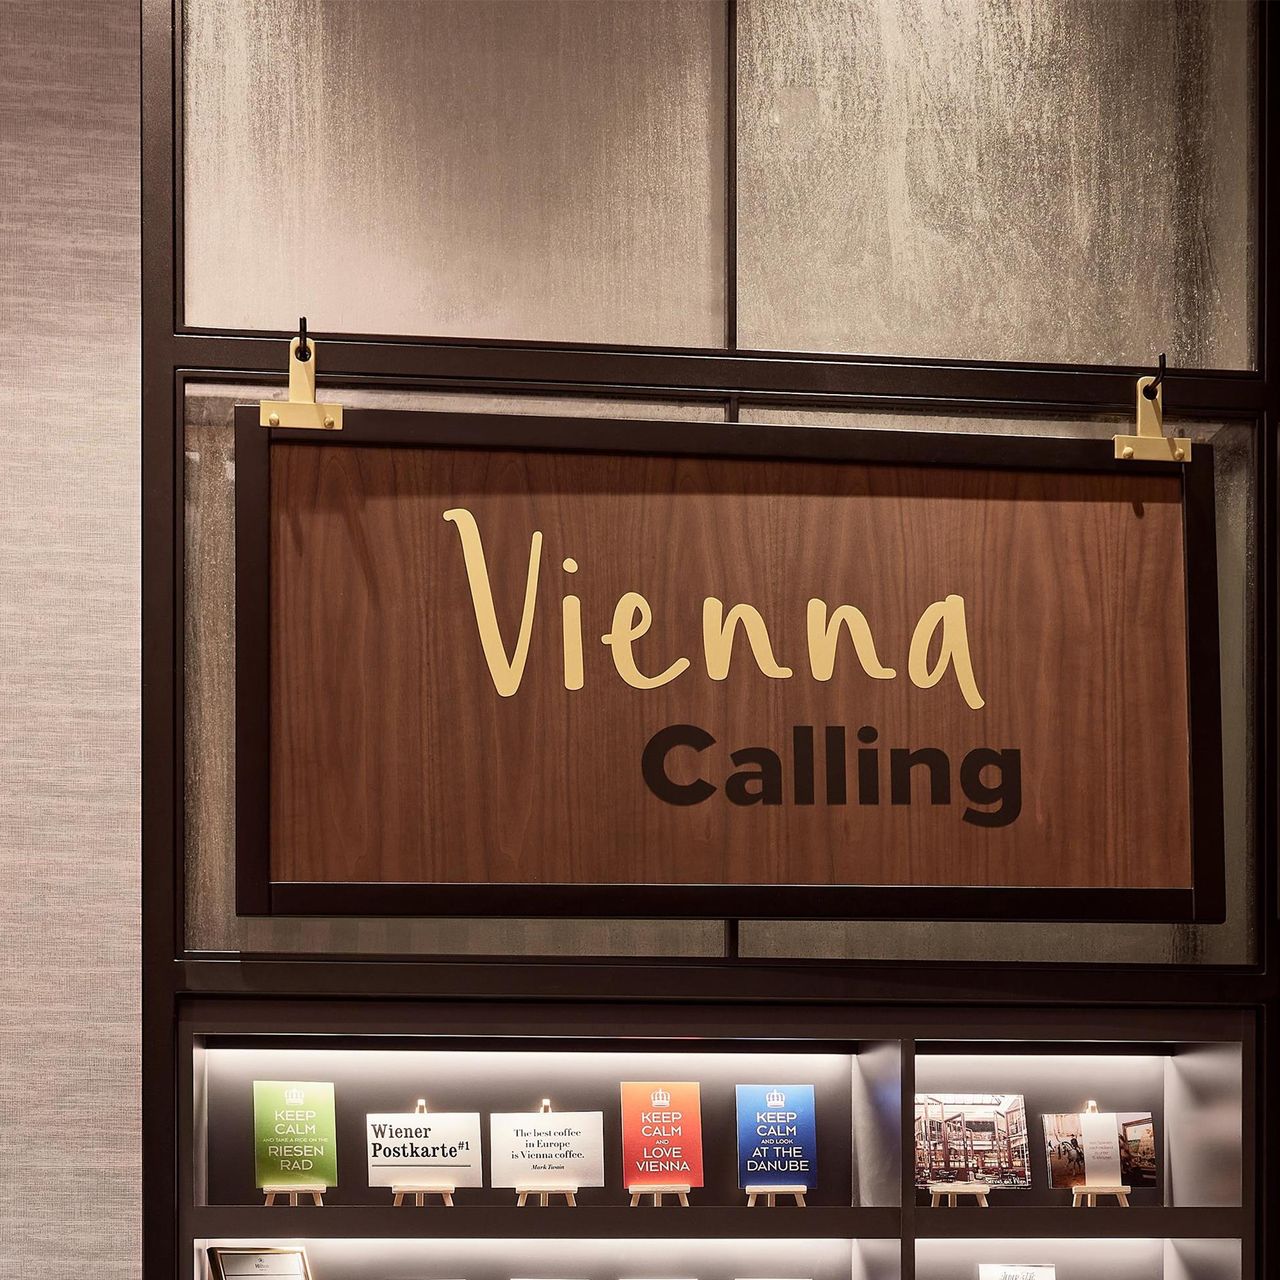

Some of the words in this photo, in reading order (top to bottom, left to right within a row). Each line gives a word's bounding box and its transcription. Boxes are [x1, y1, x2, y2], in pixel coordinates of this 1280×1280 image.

[443, 508, 985, 710] Vienna
[641, 724, 1022, 828] Calling
[275, 1110, 316, 1121] KEEP
[641, 1112, 682, 1123] KEEP
[756, 1112, 797, 1123] KEEP
[275, 1123, 316, 1135] CALM
[371, 1124, 432, 1138] Wiener
[513, 1129, 532, 1137] The
[533, 1129, 552, 1137] best
[553, 1128, 581, 1137] coffee
[641, 1125, 682, 1137] CALM
[756, 1125, 797, 1136] CALM
[525, 1140, 535, 1148] in
[537, 1140, 570, 1150] Europe
[268, 1145, 324, 1157] RIESEN
[511, 1151, 519, 1159] is
[520, 1150, 553, 1159] Vienna
[554, 1150, 585, 1159] coffee.
[643, 1147, 682, 1158] LOVE
[752, 1147, 770, 1157] AT
[773, 1146, 803, 1157] THE
[280, 1160, 313, 1171] RAD
[636, 1161, 691, 1172] VIENNA
[747, 1160, 809, 1172] DANUBE
